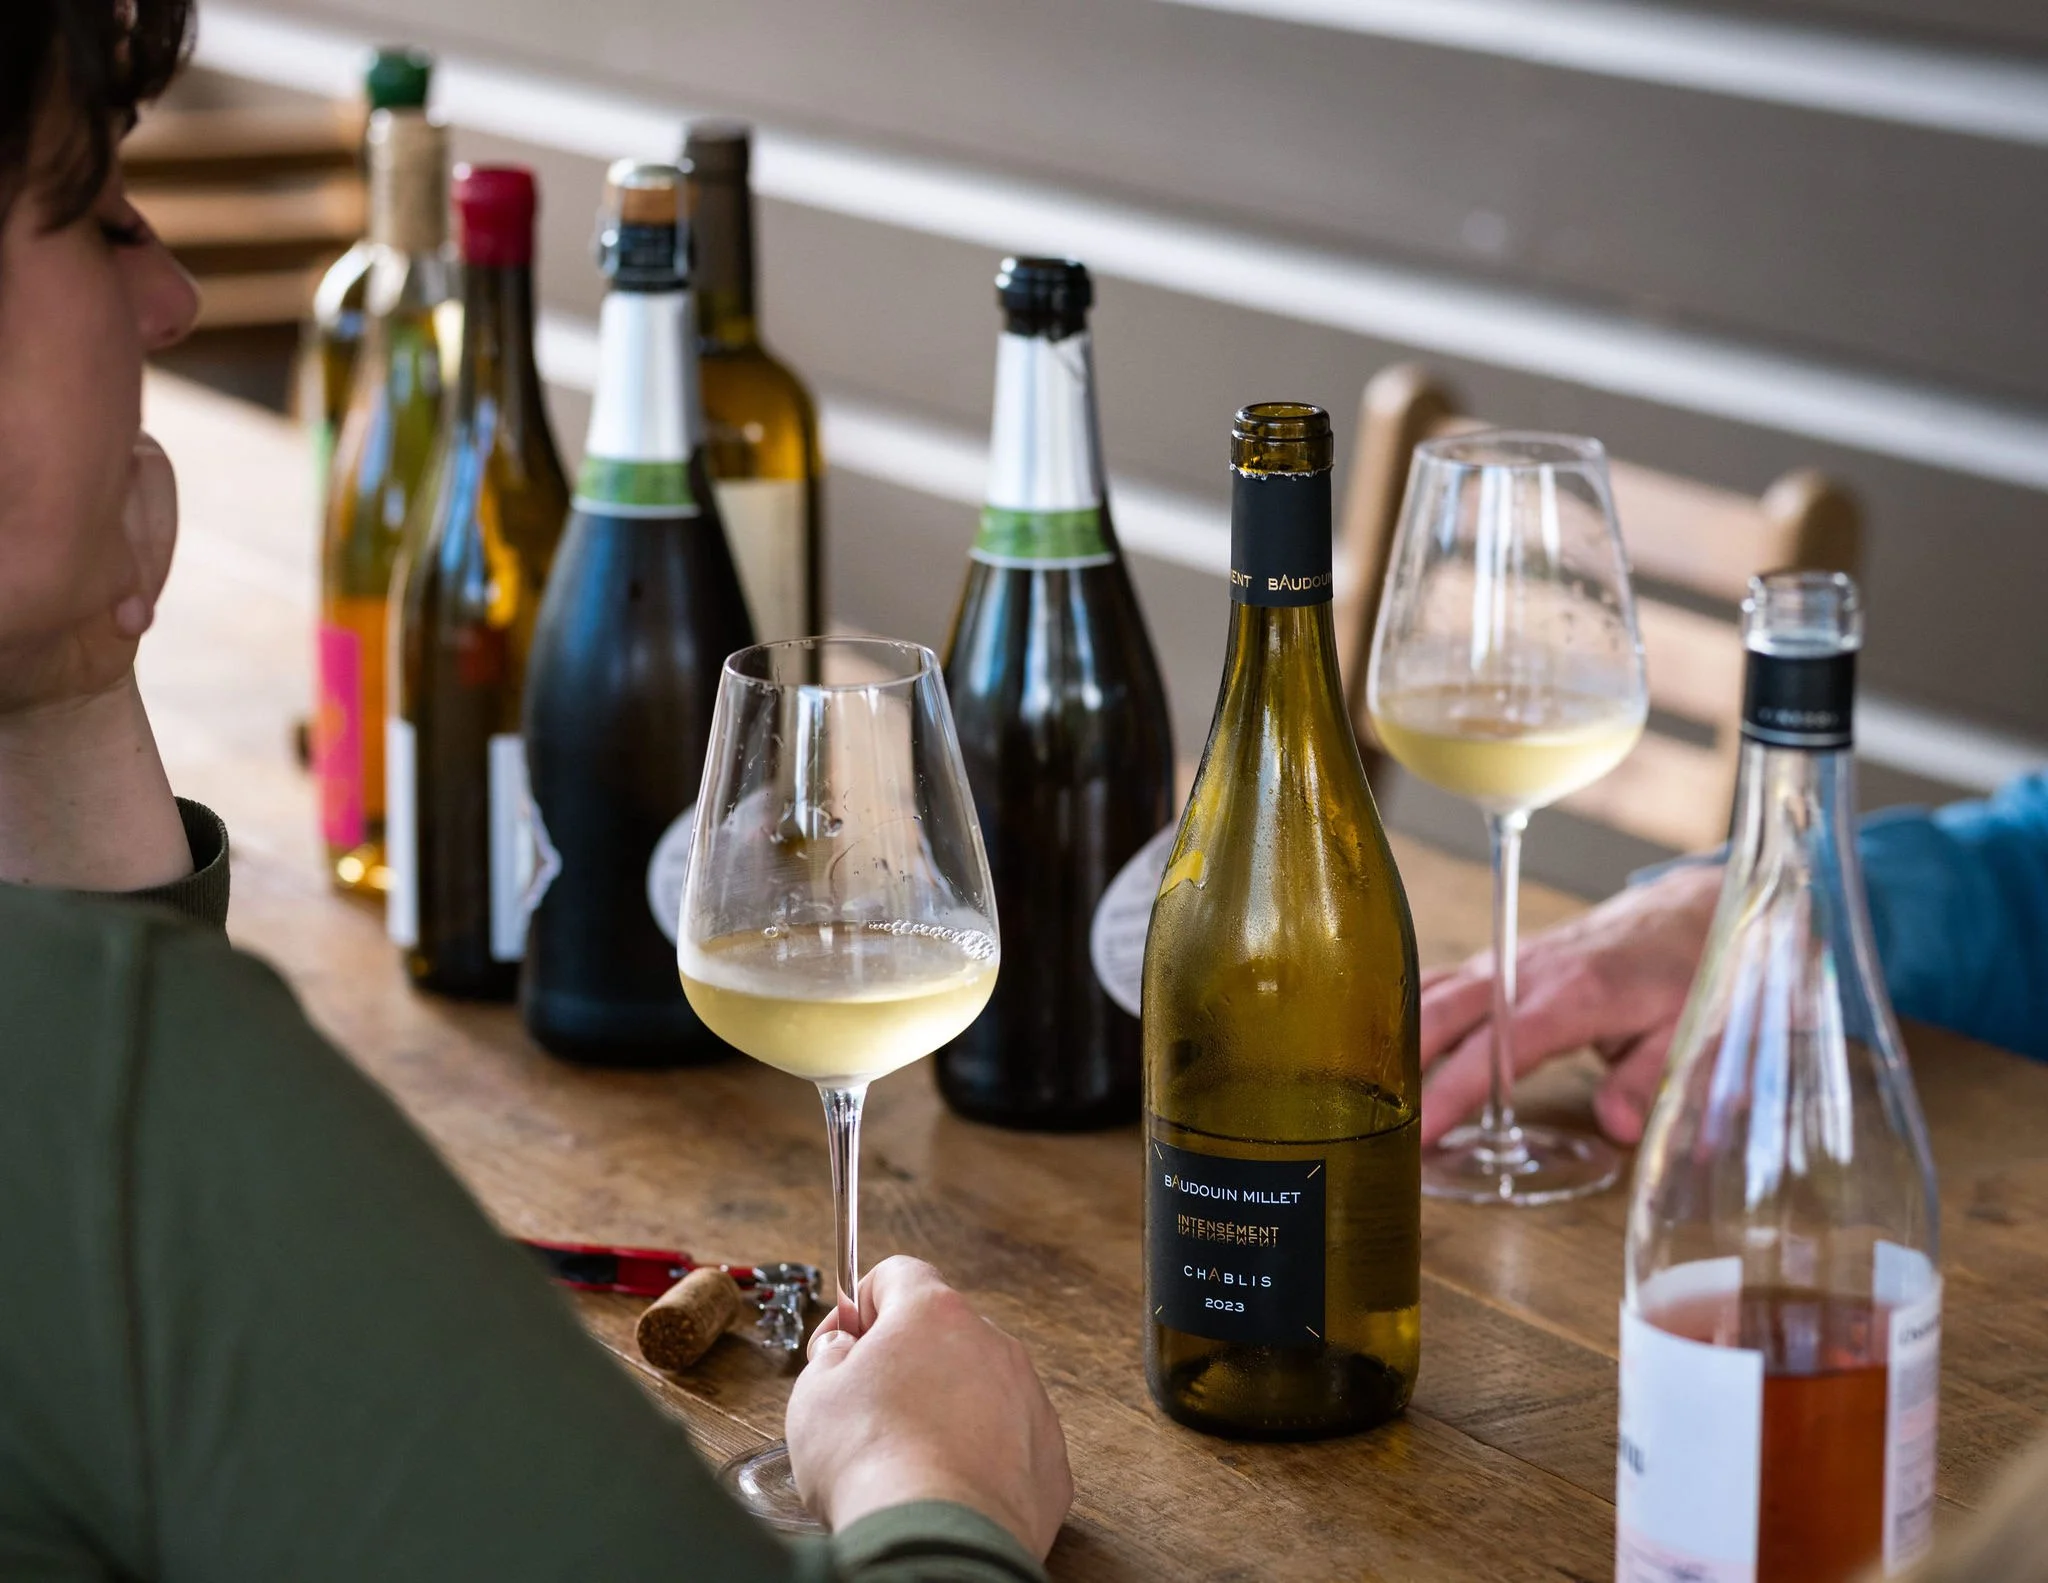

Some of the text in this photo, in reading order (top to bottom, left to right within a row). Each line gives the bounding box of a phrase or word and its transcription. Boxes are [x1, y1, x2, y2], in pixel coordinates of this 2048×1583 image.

[1164, 1174, 1301, 1204] BAUDOUIN MILLET
[1177, 1213, 1279, 1237] INTENSÉMENT
[1183, 1265, 1272, 1288] CHABLIS
[1205, 1298, 1245, 1312] 2023
